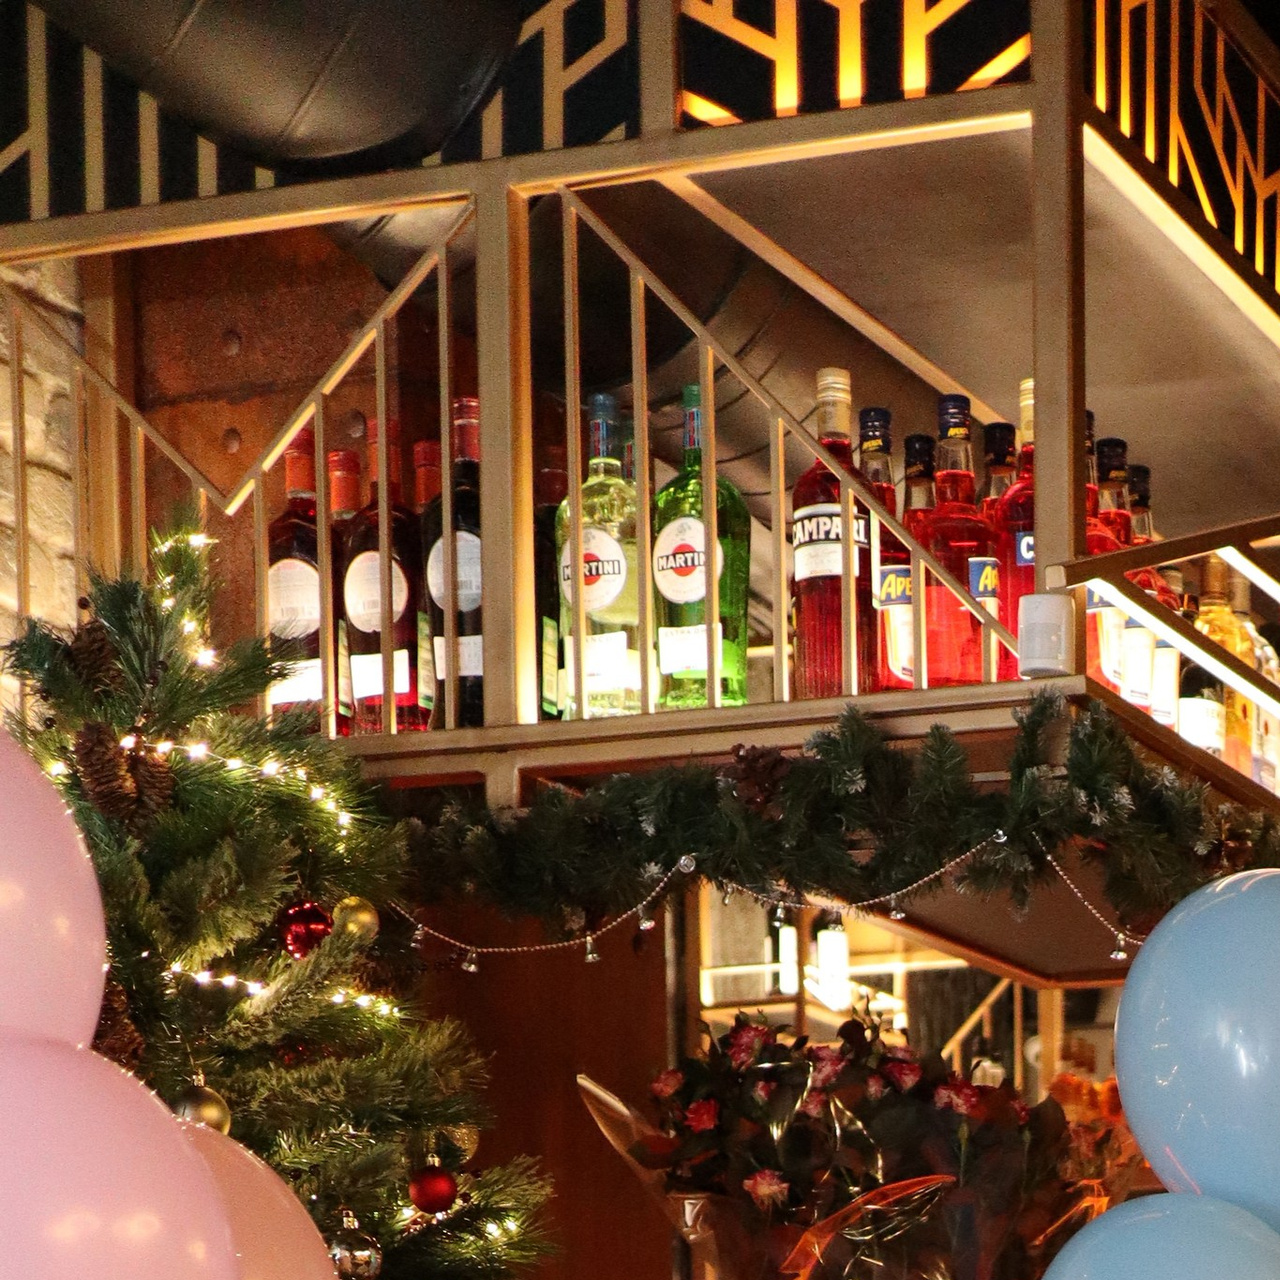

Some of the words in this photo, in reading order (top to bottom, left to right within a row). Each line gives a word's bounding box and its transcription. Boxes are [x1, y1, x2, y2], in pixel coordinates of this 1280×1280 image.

[563, 560, 620, 581] MRTINI
[658, 551, 706, 571] MARTIN
[879, 572, 912, 601] APE
